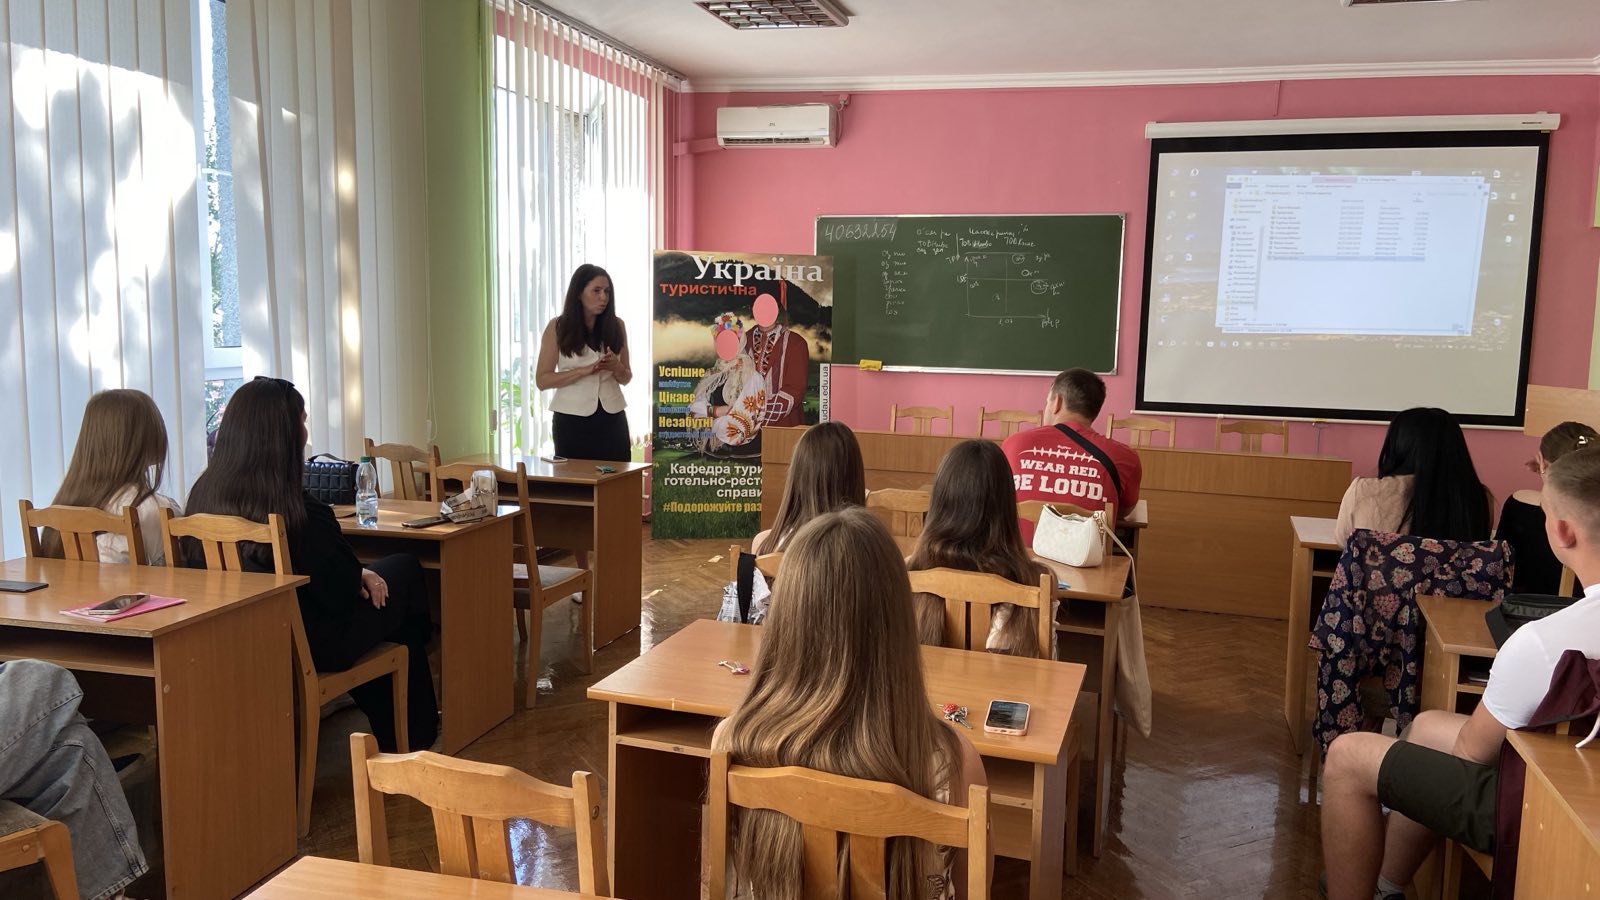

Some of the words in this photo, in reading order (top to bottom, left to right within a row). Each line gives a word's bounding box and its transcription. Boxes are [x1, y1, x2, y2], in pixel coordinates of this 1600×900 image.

[691, 254, 824, 287] Україна
[659, 283, 757, 297] туристична
[659, 366, 705, 378] Успішне
[659, 391, 696, 404] Цікаве
[659, 416, 713, 428] Незабутні
[670, 463, 730, 476] Кафедра
[1020, 459, 1065, 474] WEAR
[1068, 465, 1101, 479] RED.
[664, 477, 762, 488] готельно-рест
[1038, 475, 1107, 502] LOUD.
[662, 501, 742, 513] #Подорожуйте
